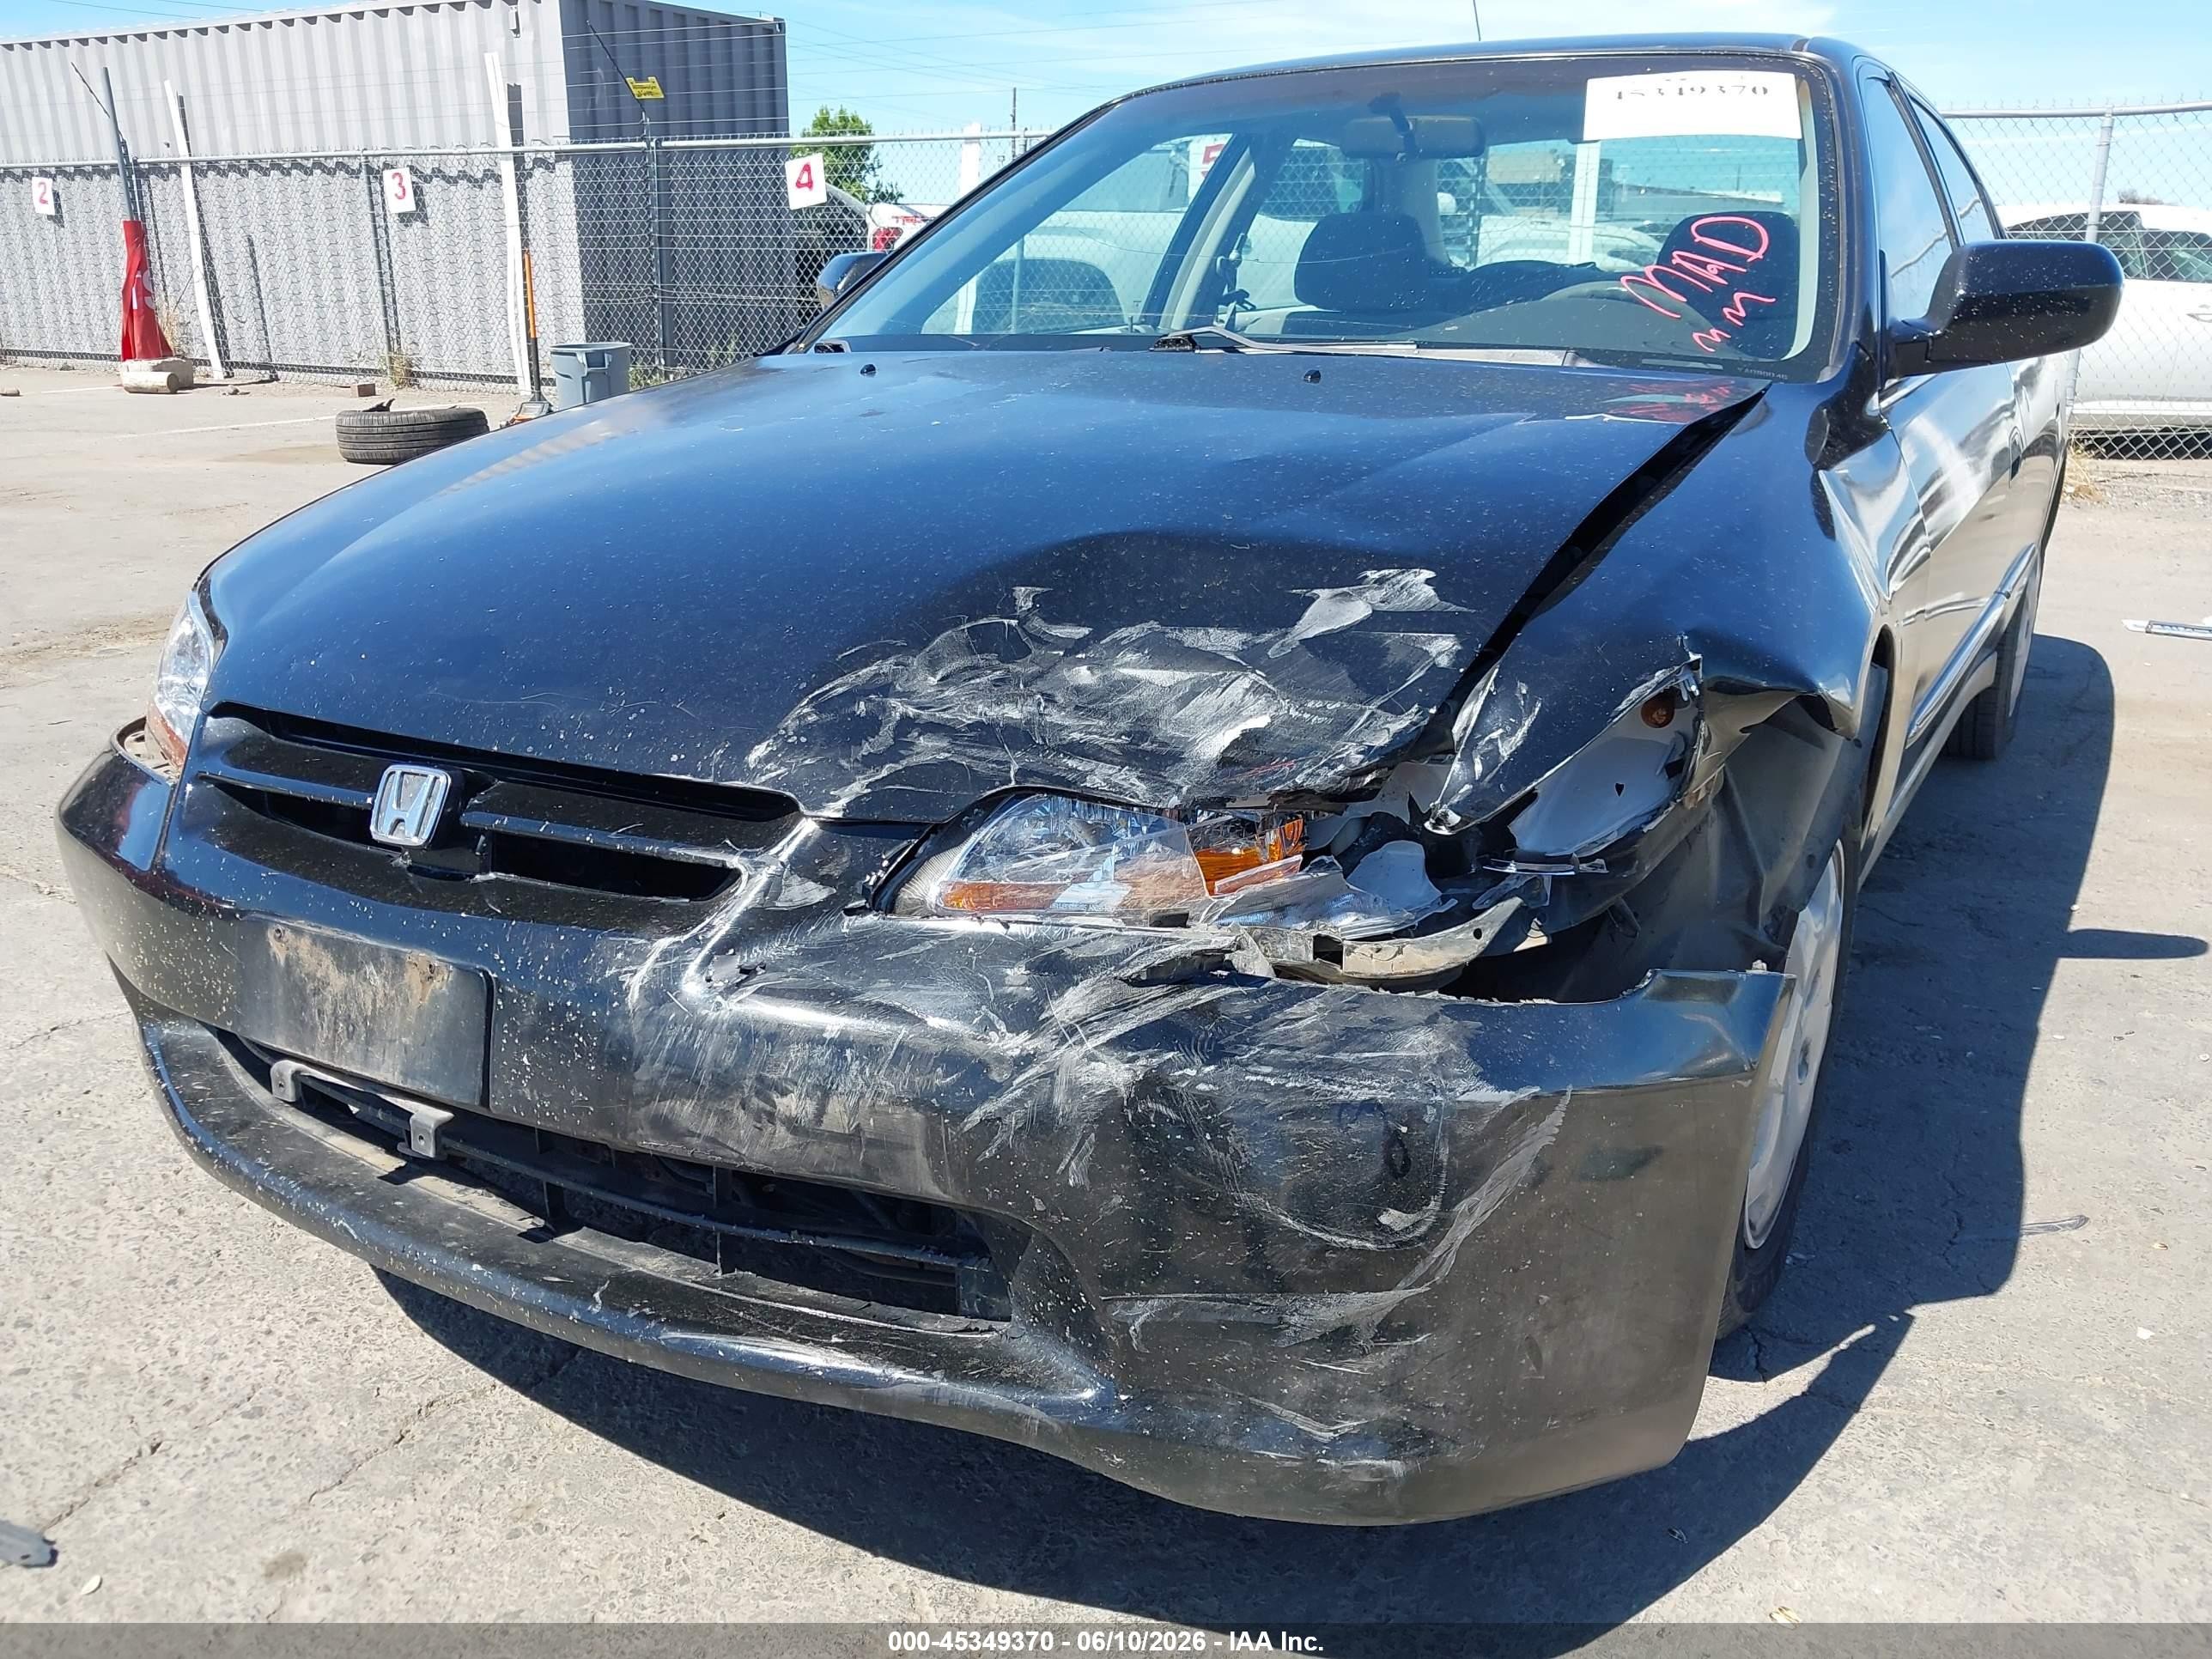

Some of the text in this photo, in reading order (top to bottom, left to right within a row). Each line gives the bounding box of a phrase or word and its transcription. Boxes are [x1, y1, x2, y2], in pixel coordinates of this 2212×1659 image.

[392, 173, 406, 199] 3
[796, 162, 813, 191] 4
[38, 181, 48, 204] 2
